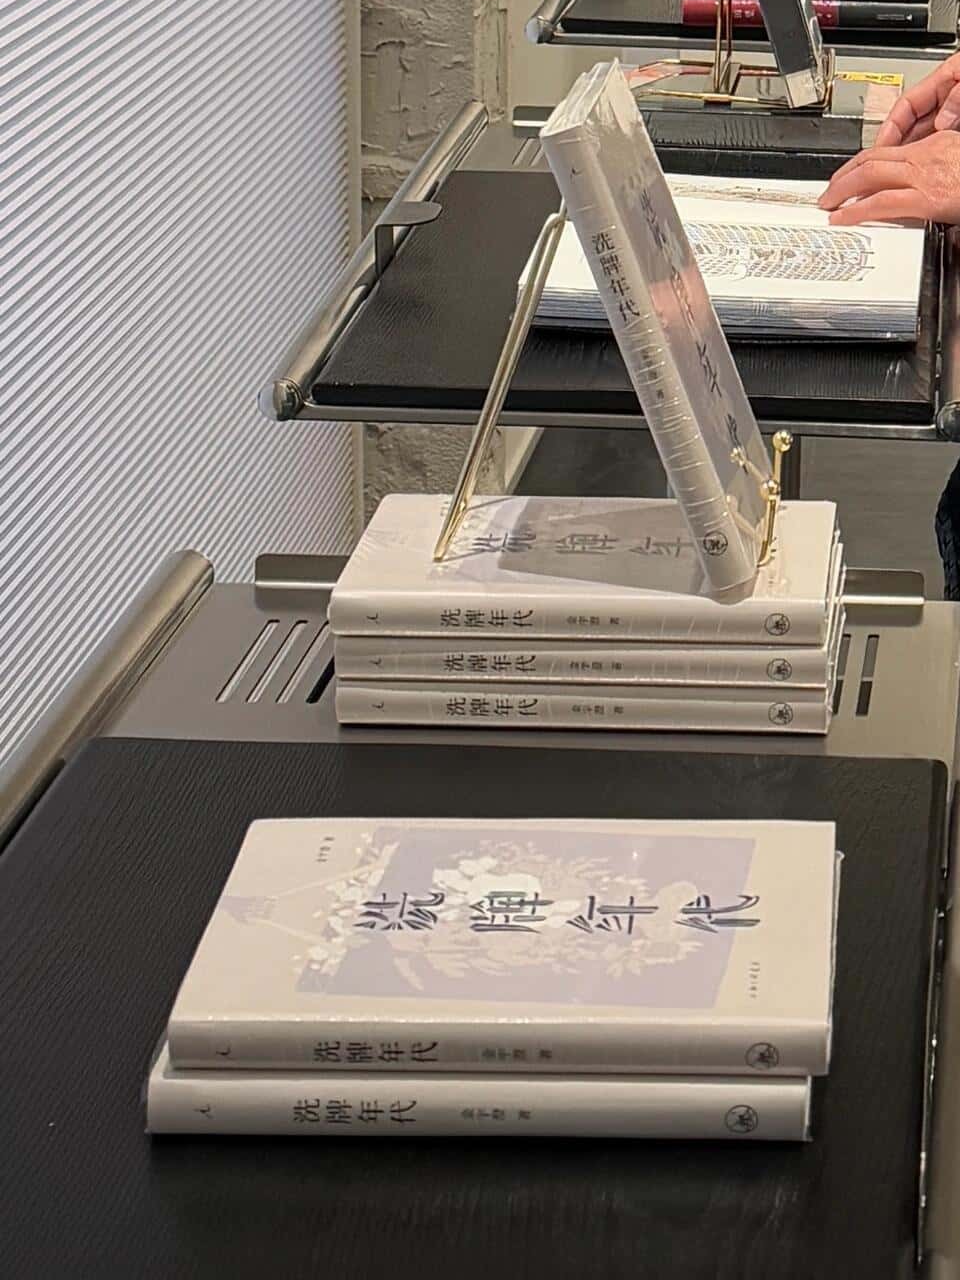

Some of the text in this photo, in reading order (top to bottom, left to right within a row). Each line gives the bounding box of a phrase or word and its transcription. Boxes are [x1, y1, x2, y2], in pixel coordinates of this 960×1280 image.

[591, 231, 640, 322] 洗牌年代
[440, 608, 534, 628] 洗牌年代
[443, 654, 537, 672] 洗牌年代
[446, 697, 539, 717] 洗牌年代
[352, 891, 761, 935] 洗牌年代
[313, 1040, 439, 1064] 洗牌年代
[292, 1098, 418, 1124] 洗牌年代
